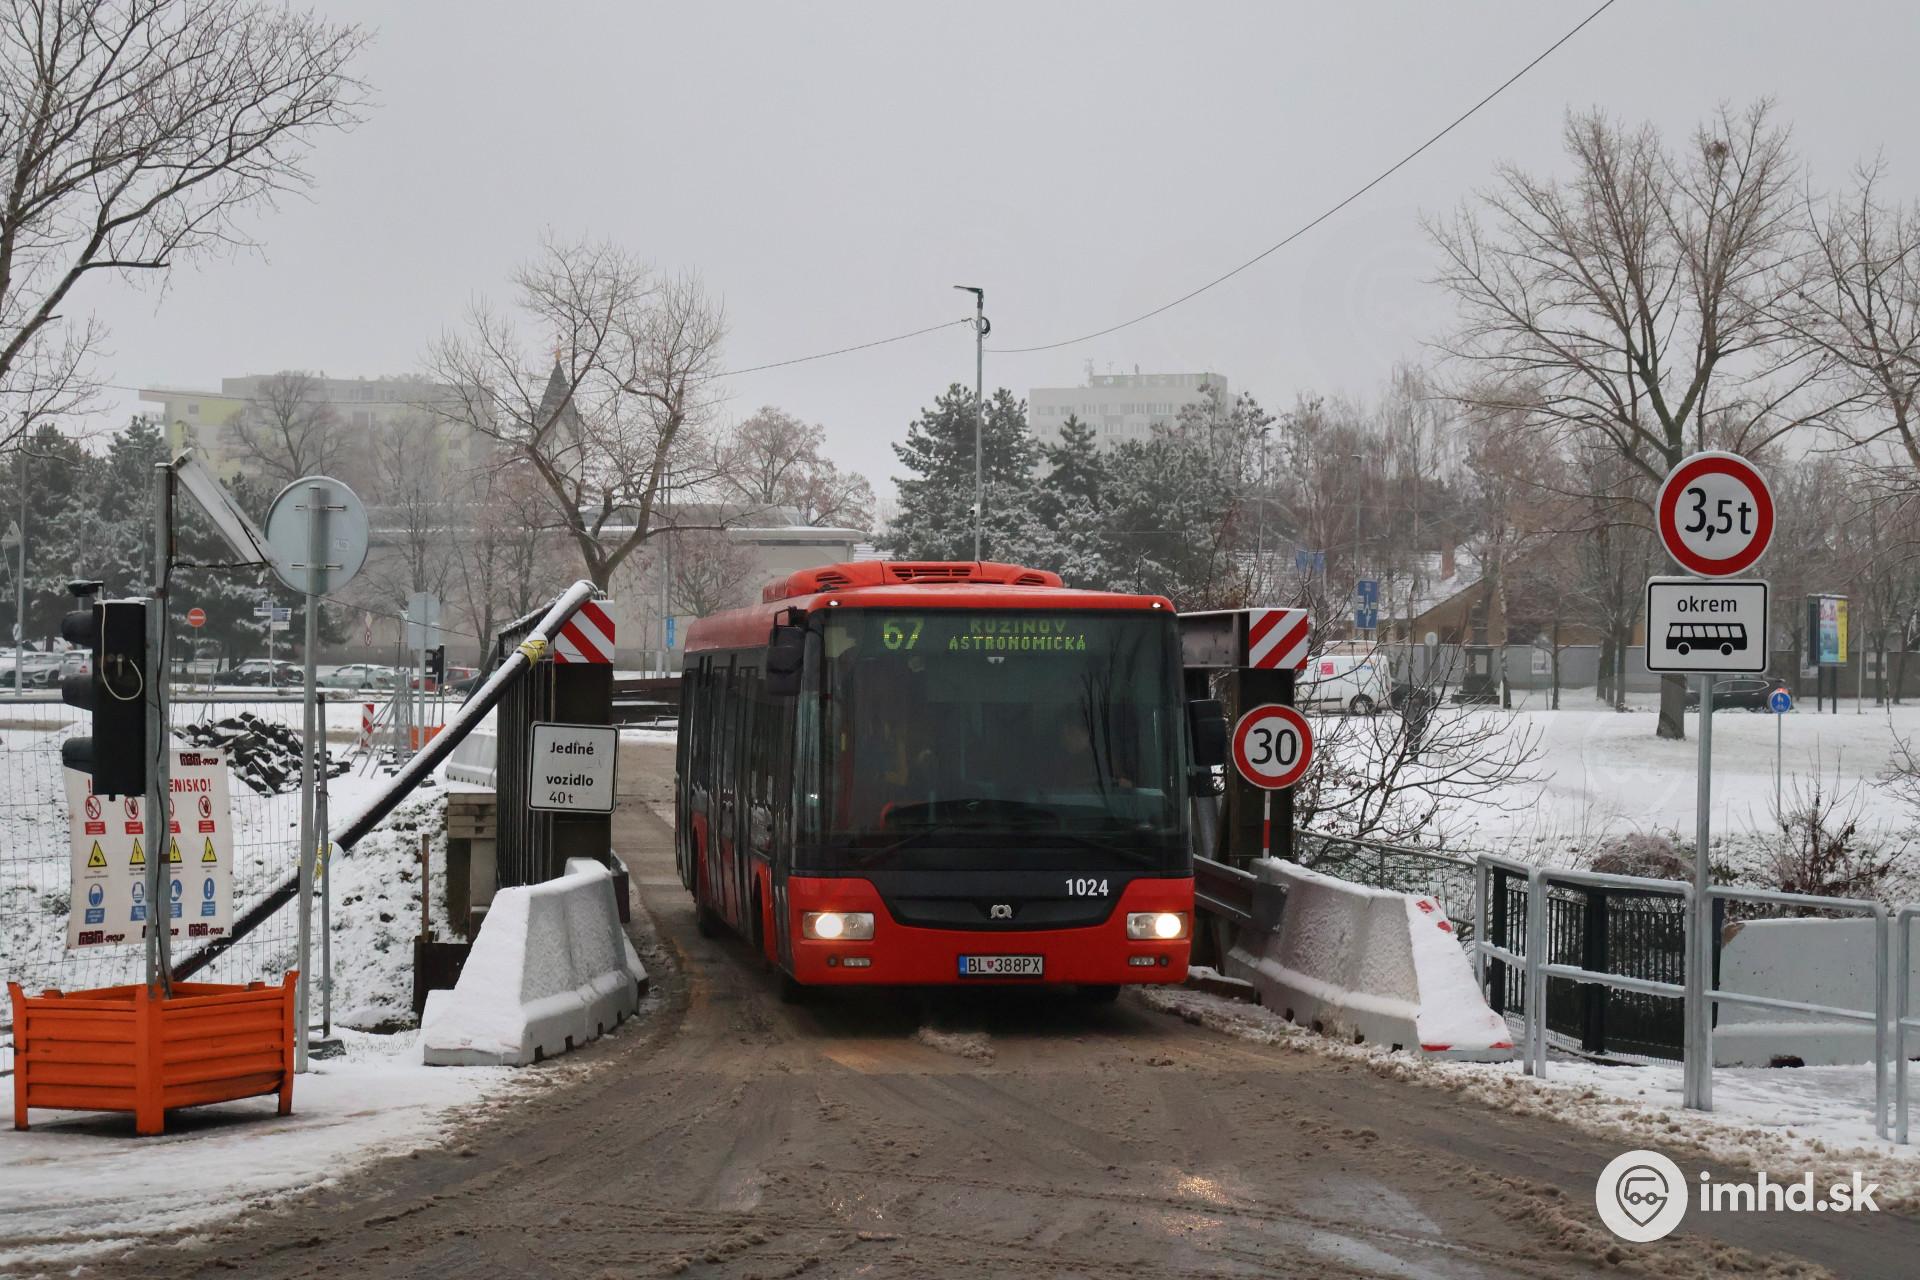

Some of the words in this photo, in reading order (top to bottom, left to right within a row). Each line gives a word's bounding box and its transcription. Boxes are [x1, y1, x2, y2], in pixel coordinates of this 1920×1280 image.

[1677, 596, 1737, 613] okrem
[883, 617, 925, 650] 67
[550, 741, 594, 755] Jediné
[1251, 728, 1297, 765] 30
[546, 773, 594, 787] vozidlo
[1065, 878, 1109, 896] 1024
